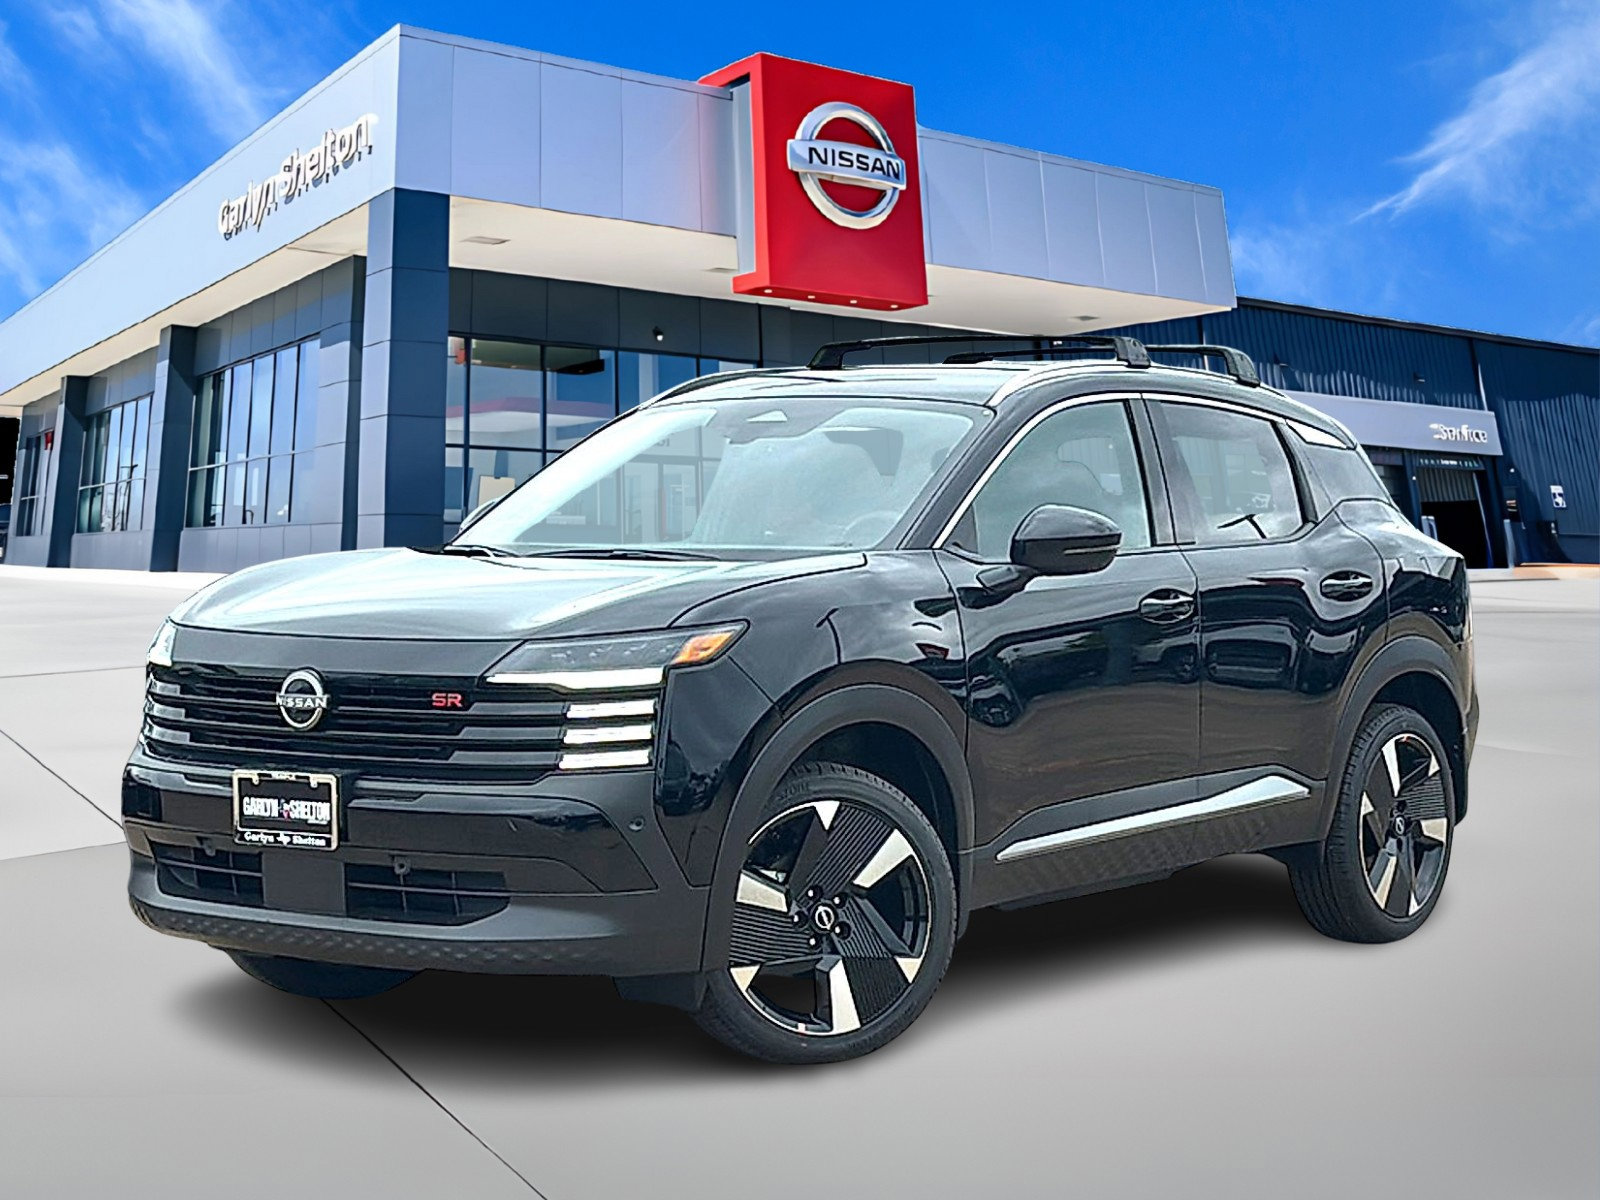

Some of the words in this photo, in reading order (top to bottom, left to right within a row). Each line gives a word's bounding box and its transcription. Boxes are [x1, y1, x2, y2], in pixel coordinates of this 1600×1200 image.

[279, 115, 376, 204] Shelton
[808, 147, 900, 180] NISSAN
[276, 693, 328, 709] NISSAN
[431, 692, 463, 708] SR
